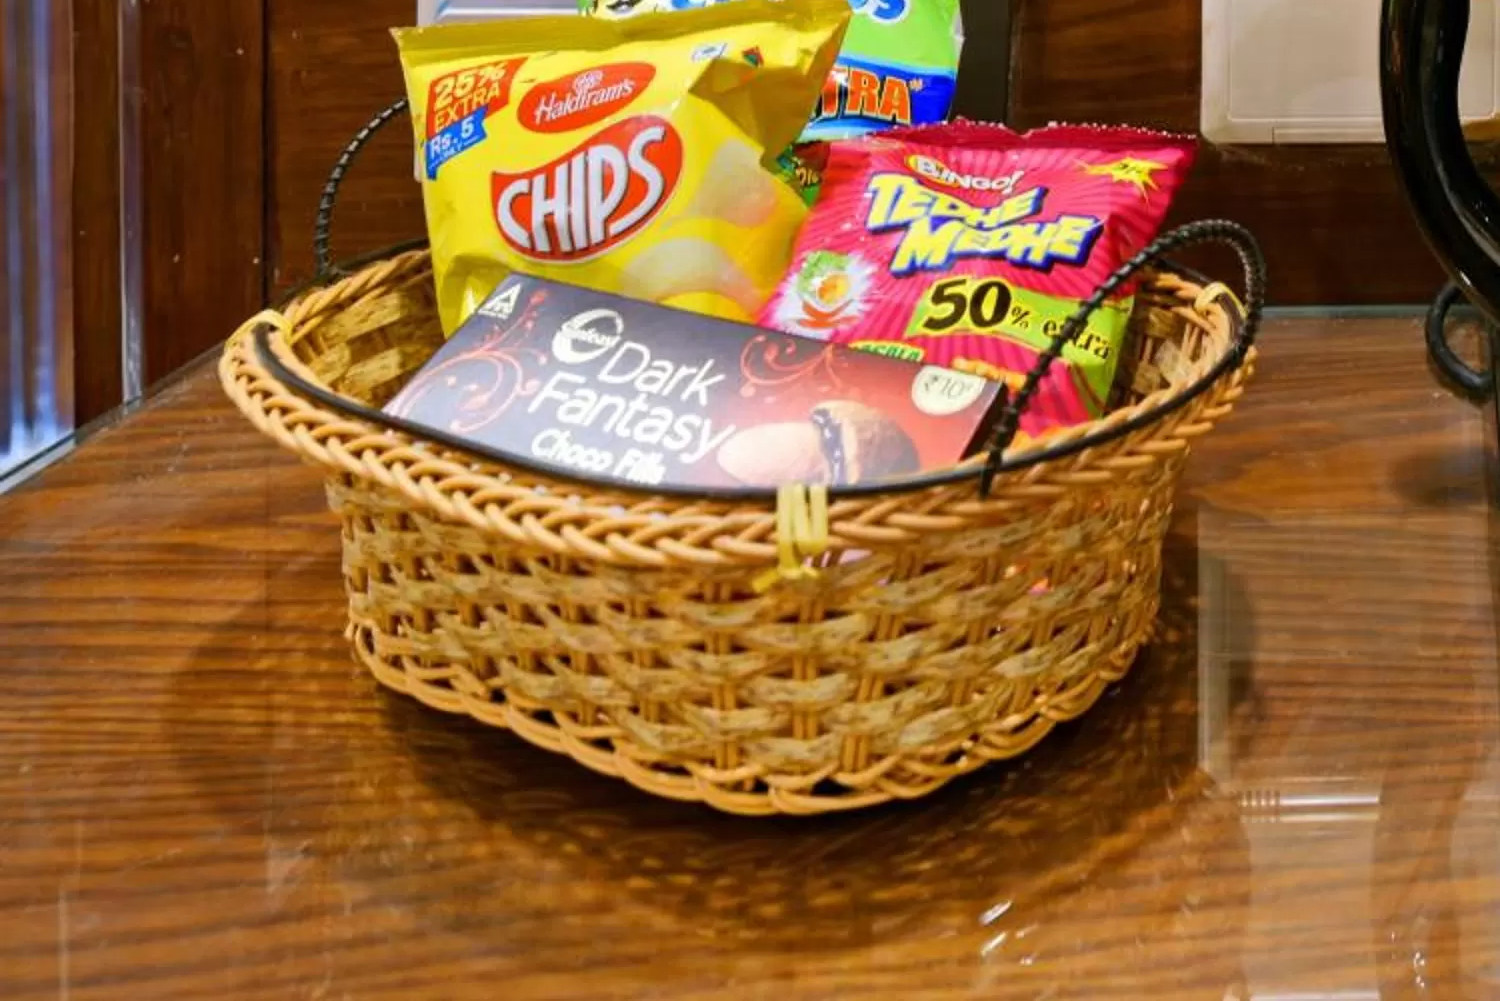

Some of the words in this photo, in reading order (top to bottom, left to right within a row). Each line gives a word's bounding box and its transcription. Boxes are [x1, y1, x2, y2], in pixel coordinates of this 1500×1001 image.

[434, 61, 507, 111] 25%
[434, 83, 501, 131] EXTRA
[460, 116, 475, 139] 5
[498, 126, 666, 253] CHIPS
[598, 341, 726, 406] Dark
[528, 371, 737, 464] Fantasy
[531, 428, 614, 472] Choco
